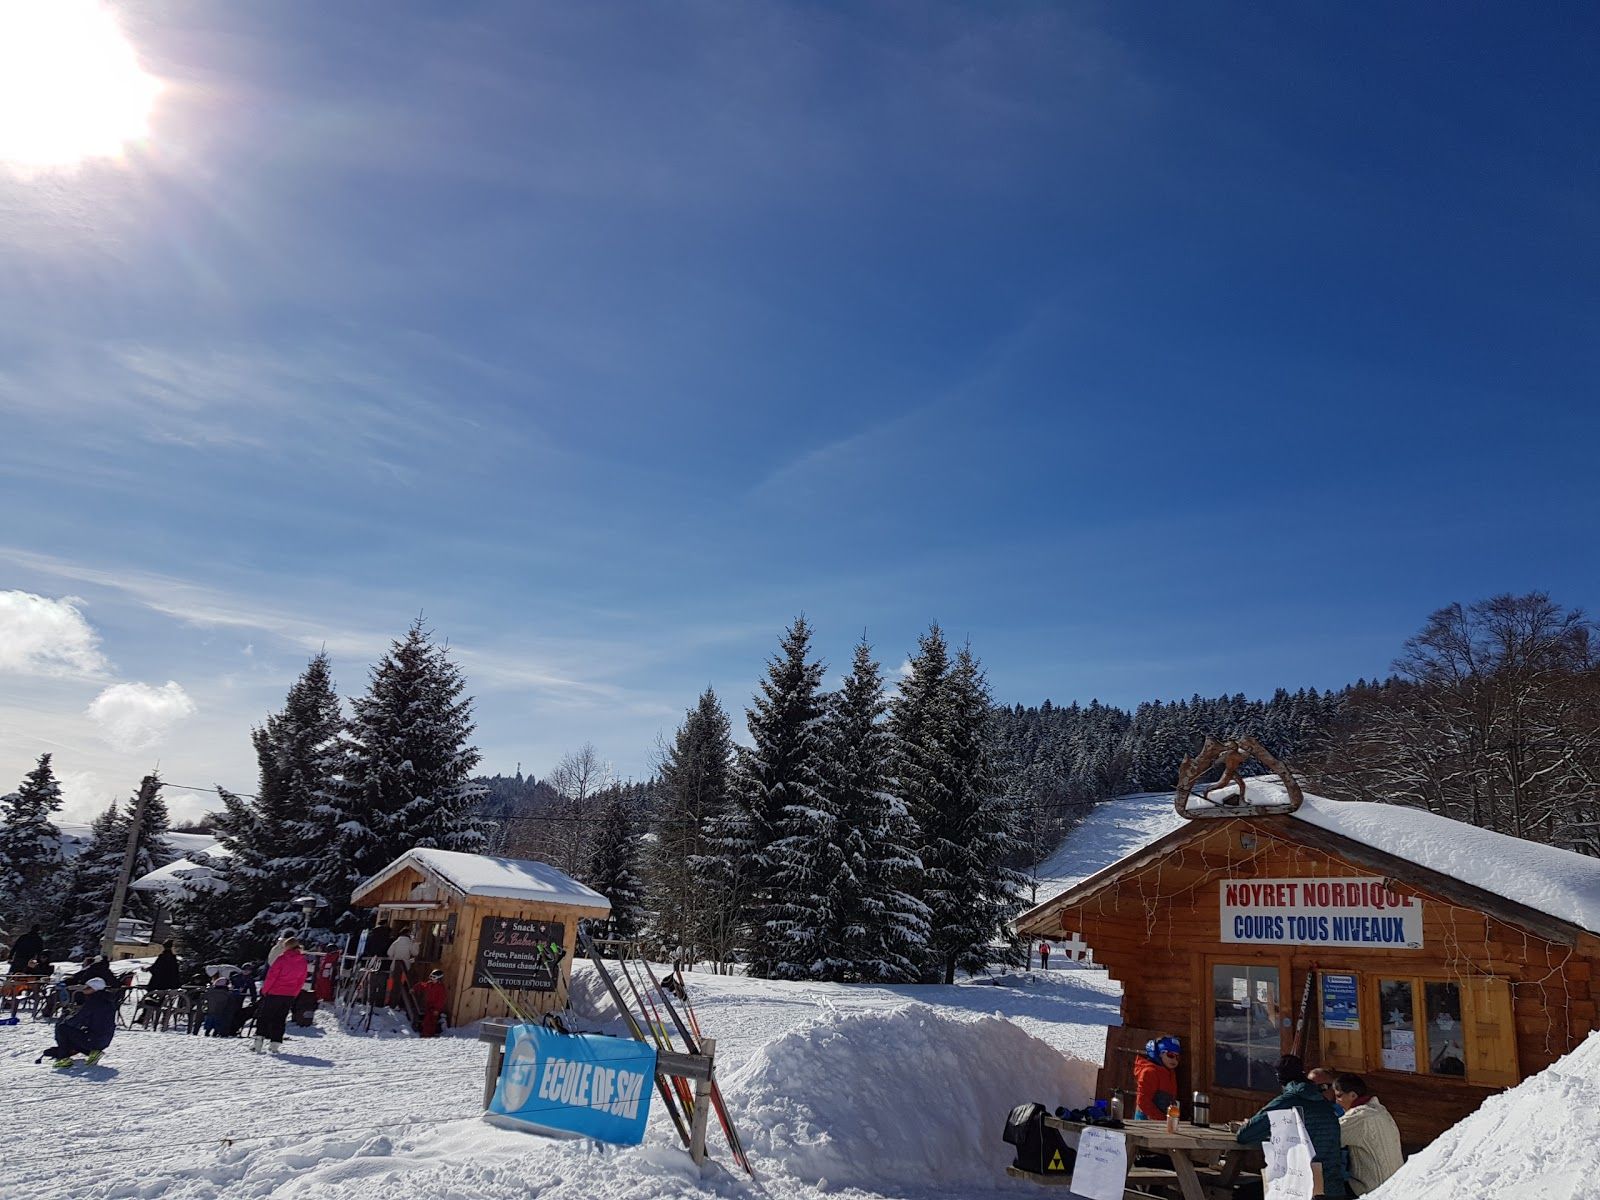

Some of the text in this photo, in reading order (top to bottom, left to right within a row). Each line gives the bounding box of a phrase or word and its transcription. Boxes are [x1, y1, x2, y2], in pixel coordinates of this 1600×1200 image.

[1226, 883, 1298, 906] NOYRET
[513, 923, 536, 932] Snack
[1234, 915, 1405, 942] COURS TOUS NIVEAUX
[484, 950, 508, 960] Crêpes,
[509, 952, 535, 960] Paninis,
[487, 960, 516, 969] Boissons
[538, 1057, 593, 1105] ECOLE
[611, 1070, 644, 1120] SKI
